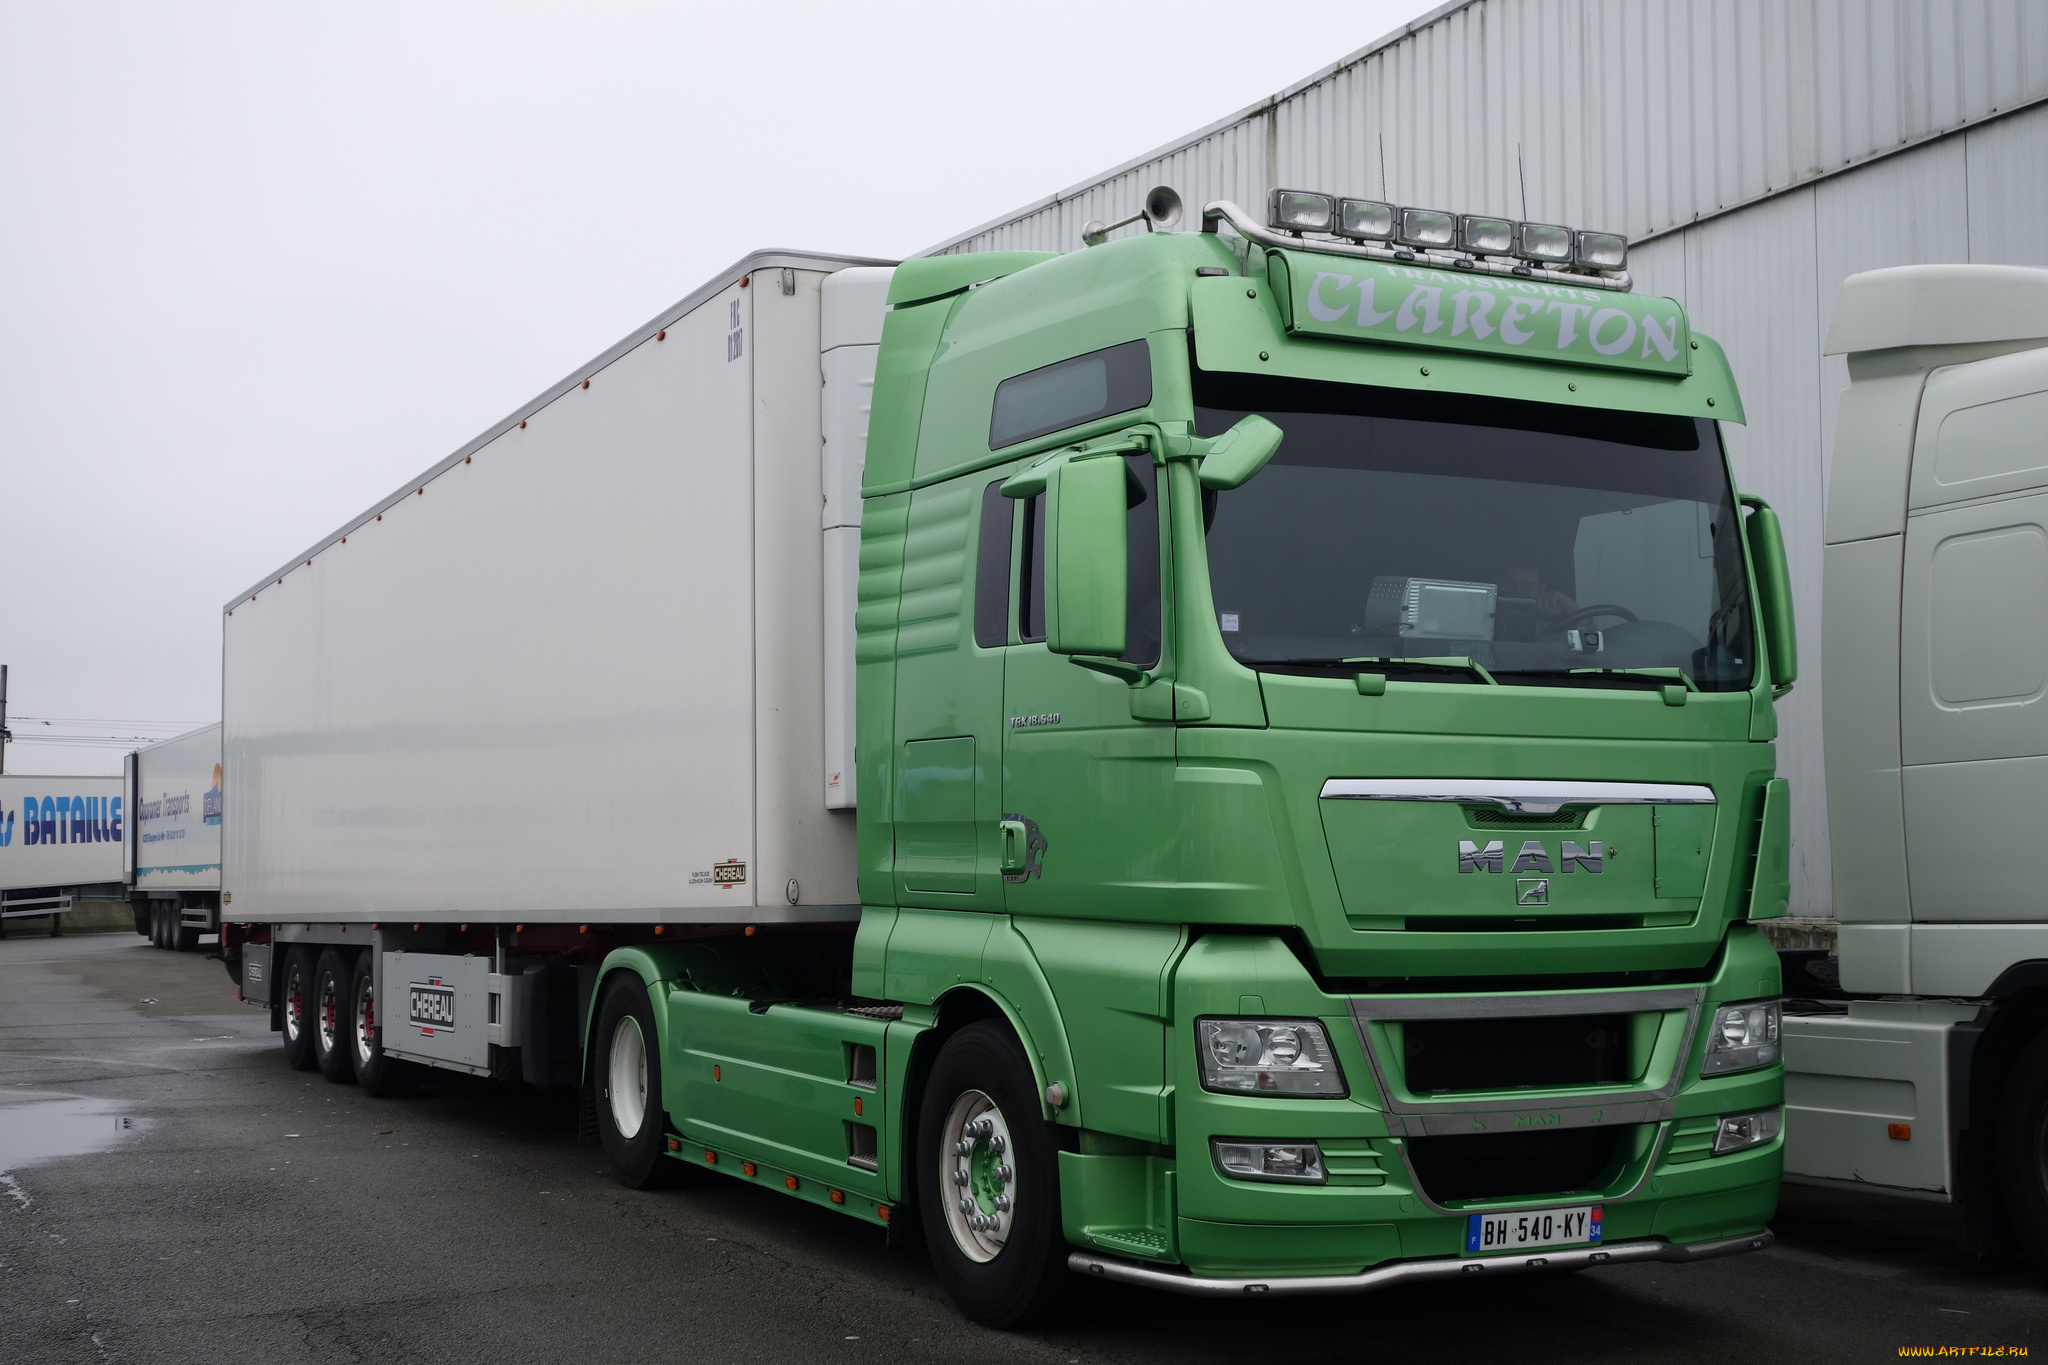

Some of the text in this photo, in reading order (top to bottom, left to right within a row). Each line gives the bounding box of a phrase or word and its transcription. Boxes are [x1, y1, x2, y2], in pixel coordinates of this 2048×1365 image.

[1379, 264, 1601, 302] TRANSPORTS
[1306, 270, 1680, 363] CLARETON
[1010, 712, 1061, 728] TGX 18.540
[23, 795, 122, 846] BATAILLE
[162, 788, 190, 821] Transports
[715, 865, 745, 881] CHEREAU
[1457, 840, 1603, 874] MAN
[410, 991, 454, 1023] CHEREAU
[1514, 1113, 1561, 1127] MAN
[1471, 1236, 1477, 1245] F
[1590, 1224, 1601, 1237] 34
